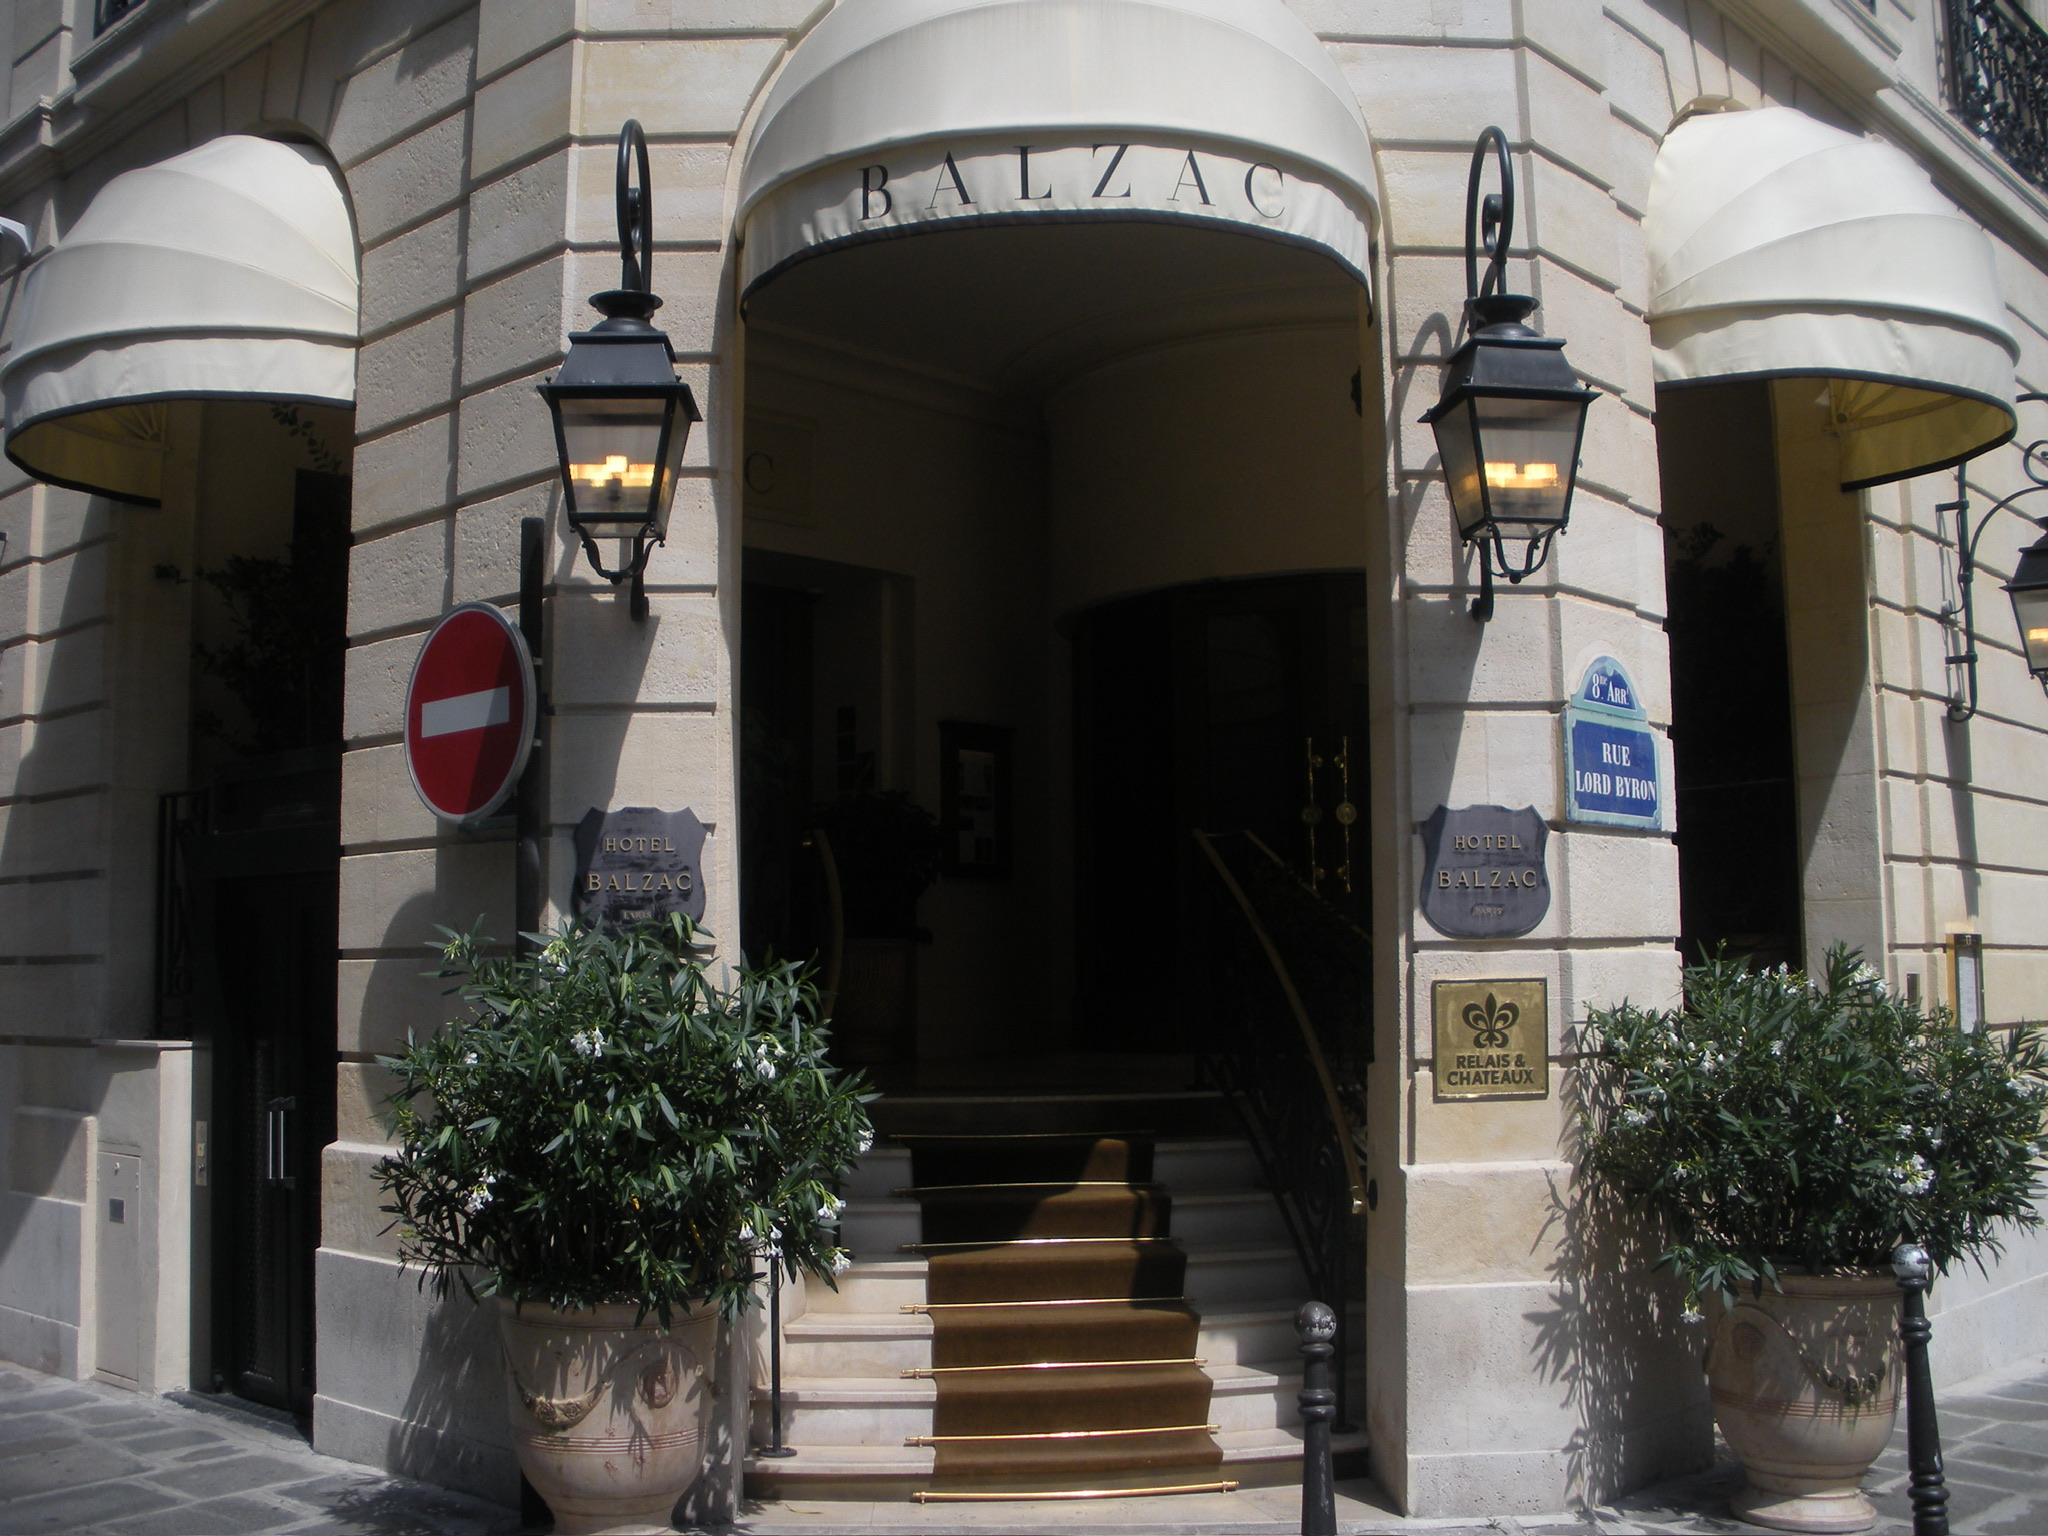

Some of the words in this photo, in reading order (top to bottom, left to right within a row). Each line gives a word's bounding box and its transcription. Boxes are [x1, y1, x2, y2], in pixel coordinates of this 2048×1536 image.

[857, 143, 1286, 222] BALZAC
[1602, 742, 1631, 767] RUE
[1575, 770, 1611, 796] LORD
[1615, 775, 1656, 801] BYRON
[604, 837, 675, 853] HOTEL
[1454, 835, 1521, 850] HOTEL
[587, 873, 693, 892] BALZAC
[1438, 870, 1537, 888] BALZAC
[1456, 1054, 1511, 1069] RELAIS
[1514, 1053, 1526, 1068] &
[1447, 1069, 1535, 1086] CHATEAUX
